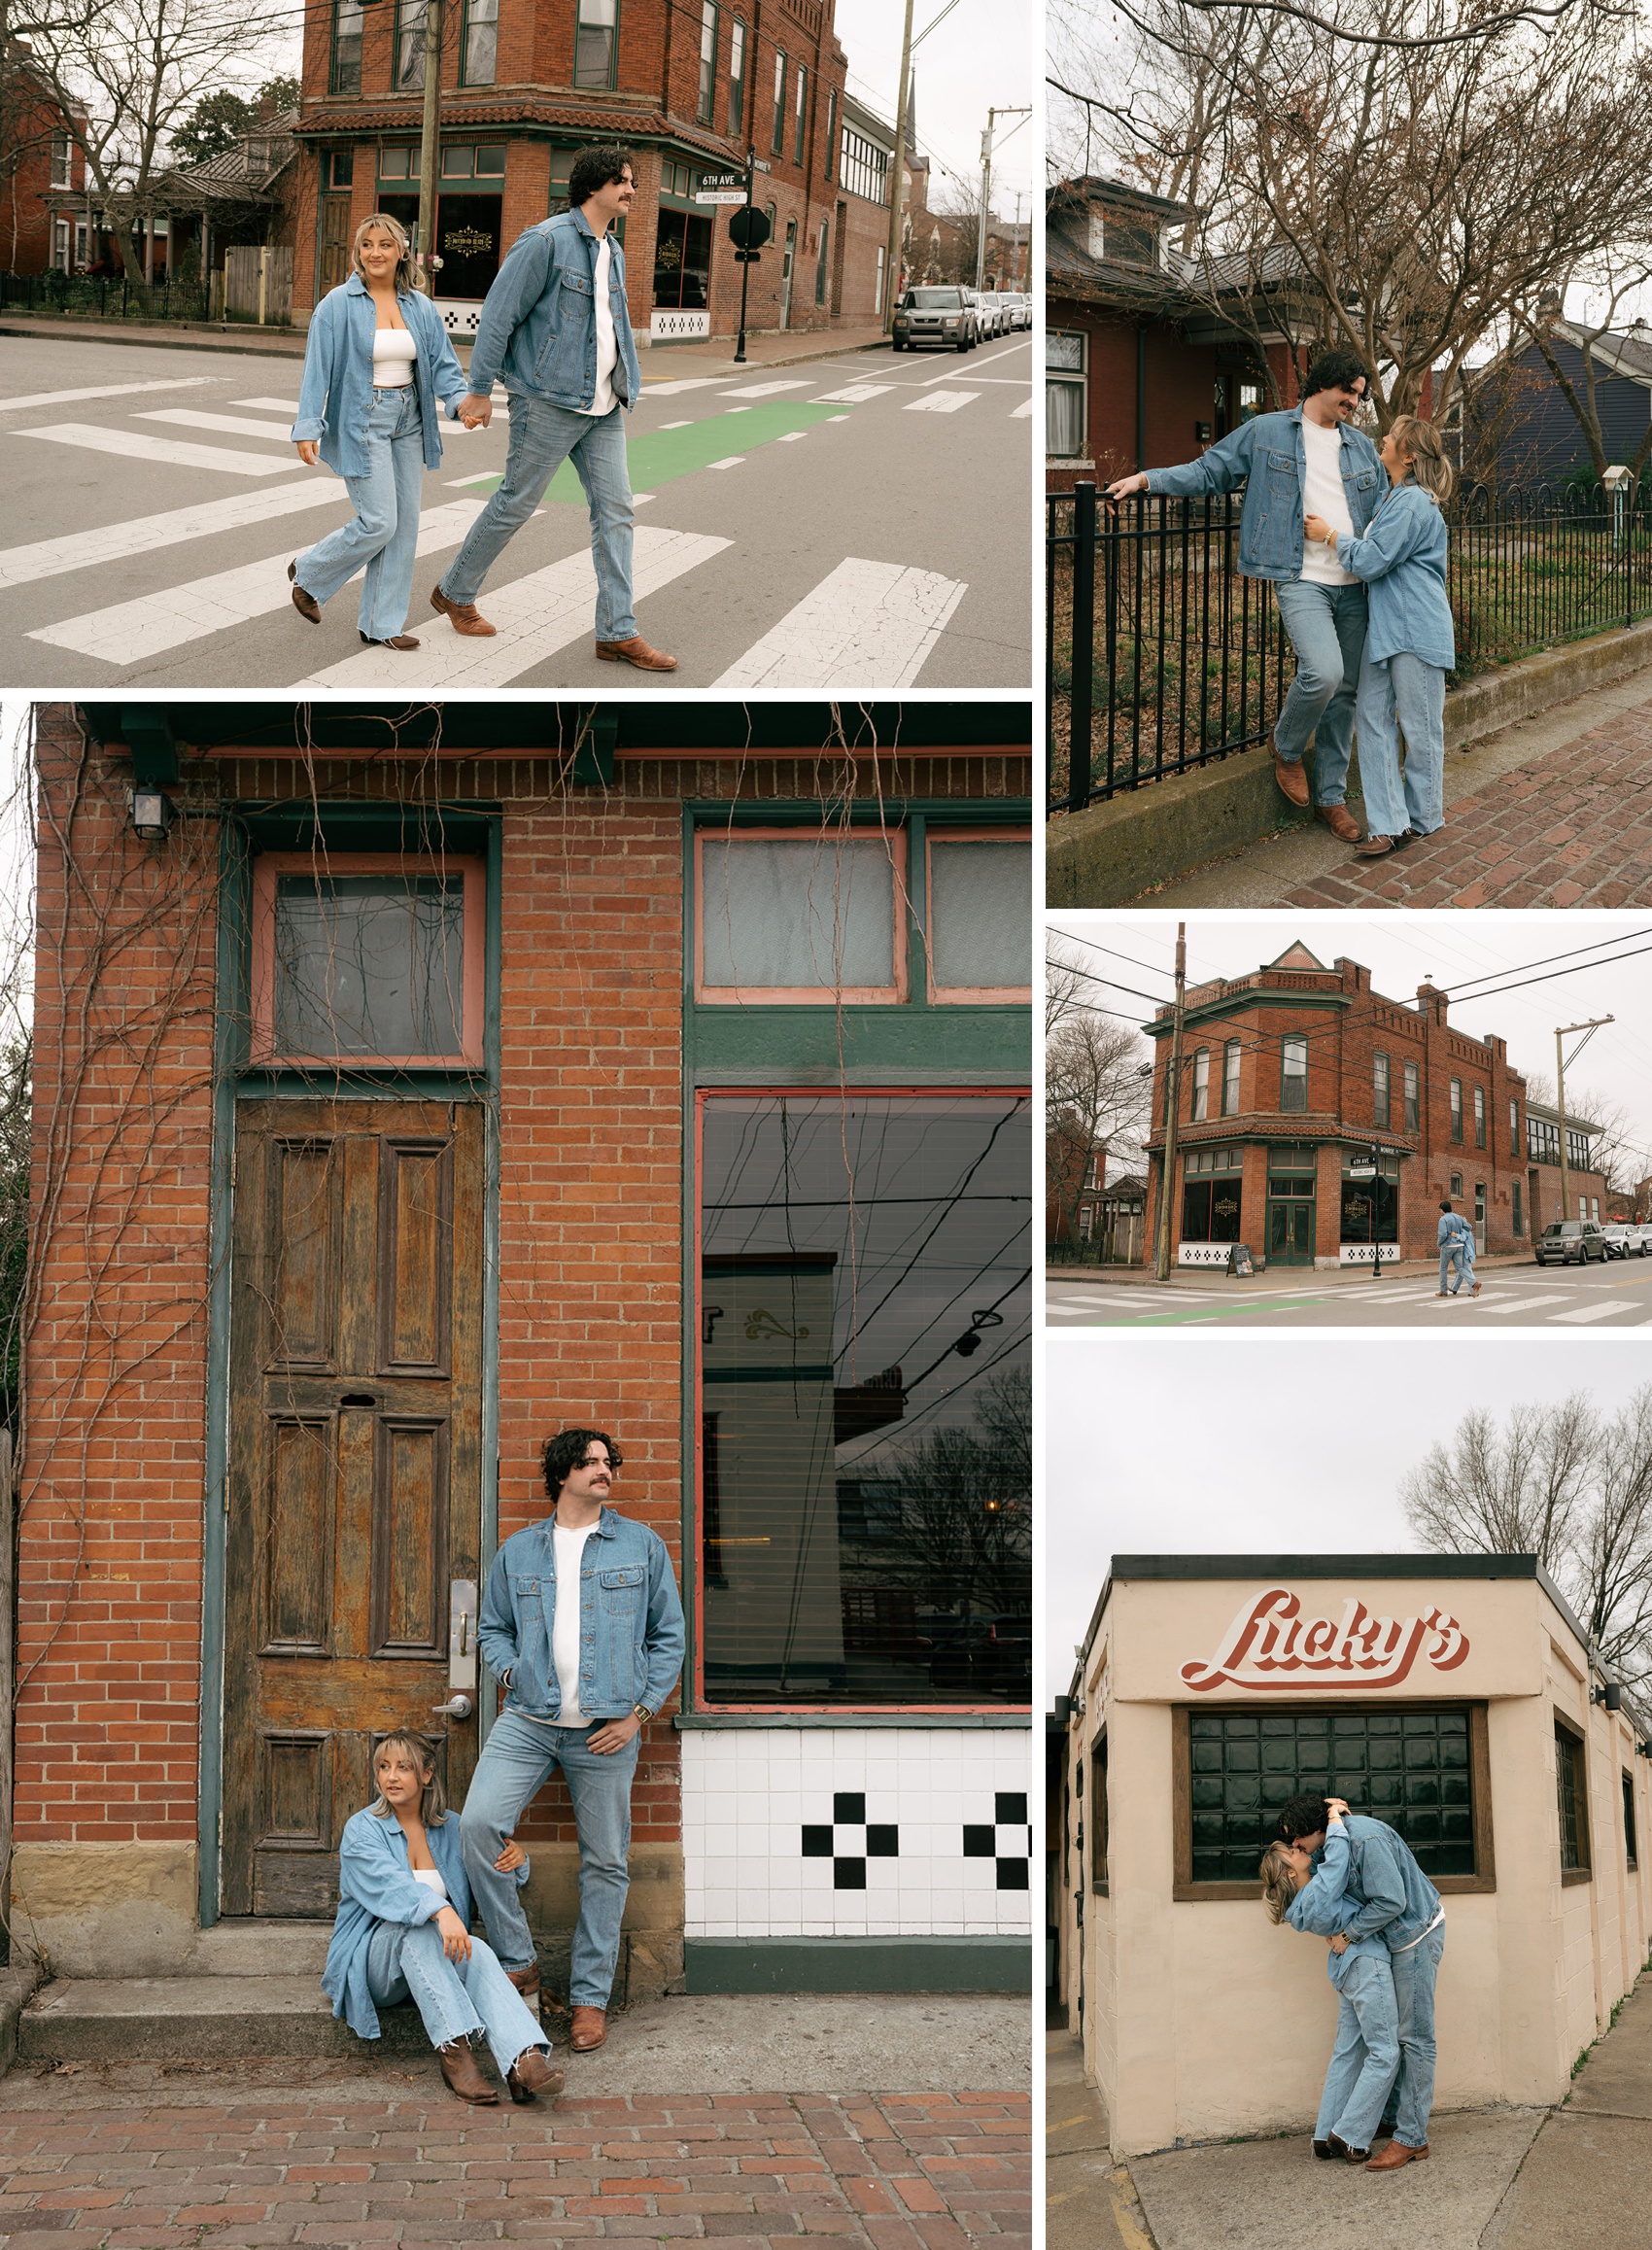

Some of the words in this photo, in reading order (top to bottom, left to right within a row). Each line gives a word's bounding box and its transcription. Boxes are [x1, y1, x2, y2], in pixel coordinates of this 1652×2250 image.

[702, 175, 717, 185] 6TH
[720, 175, 735, 185] AVE
[1178, 1586, 1470, 1691] Lucky's
